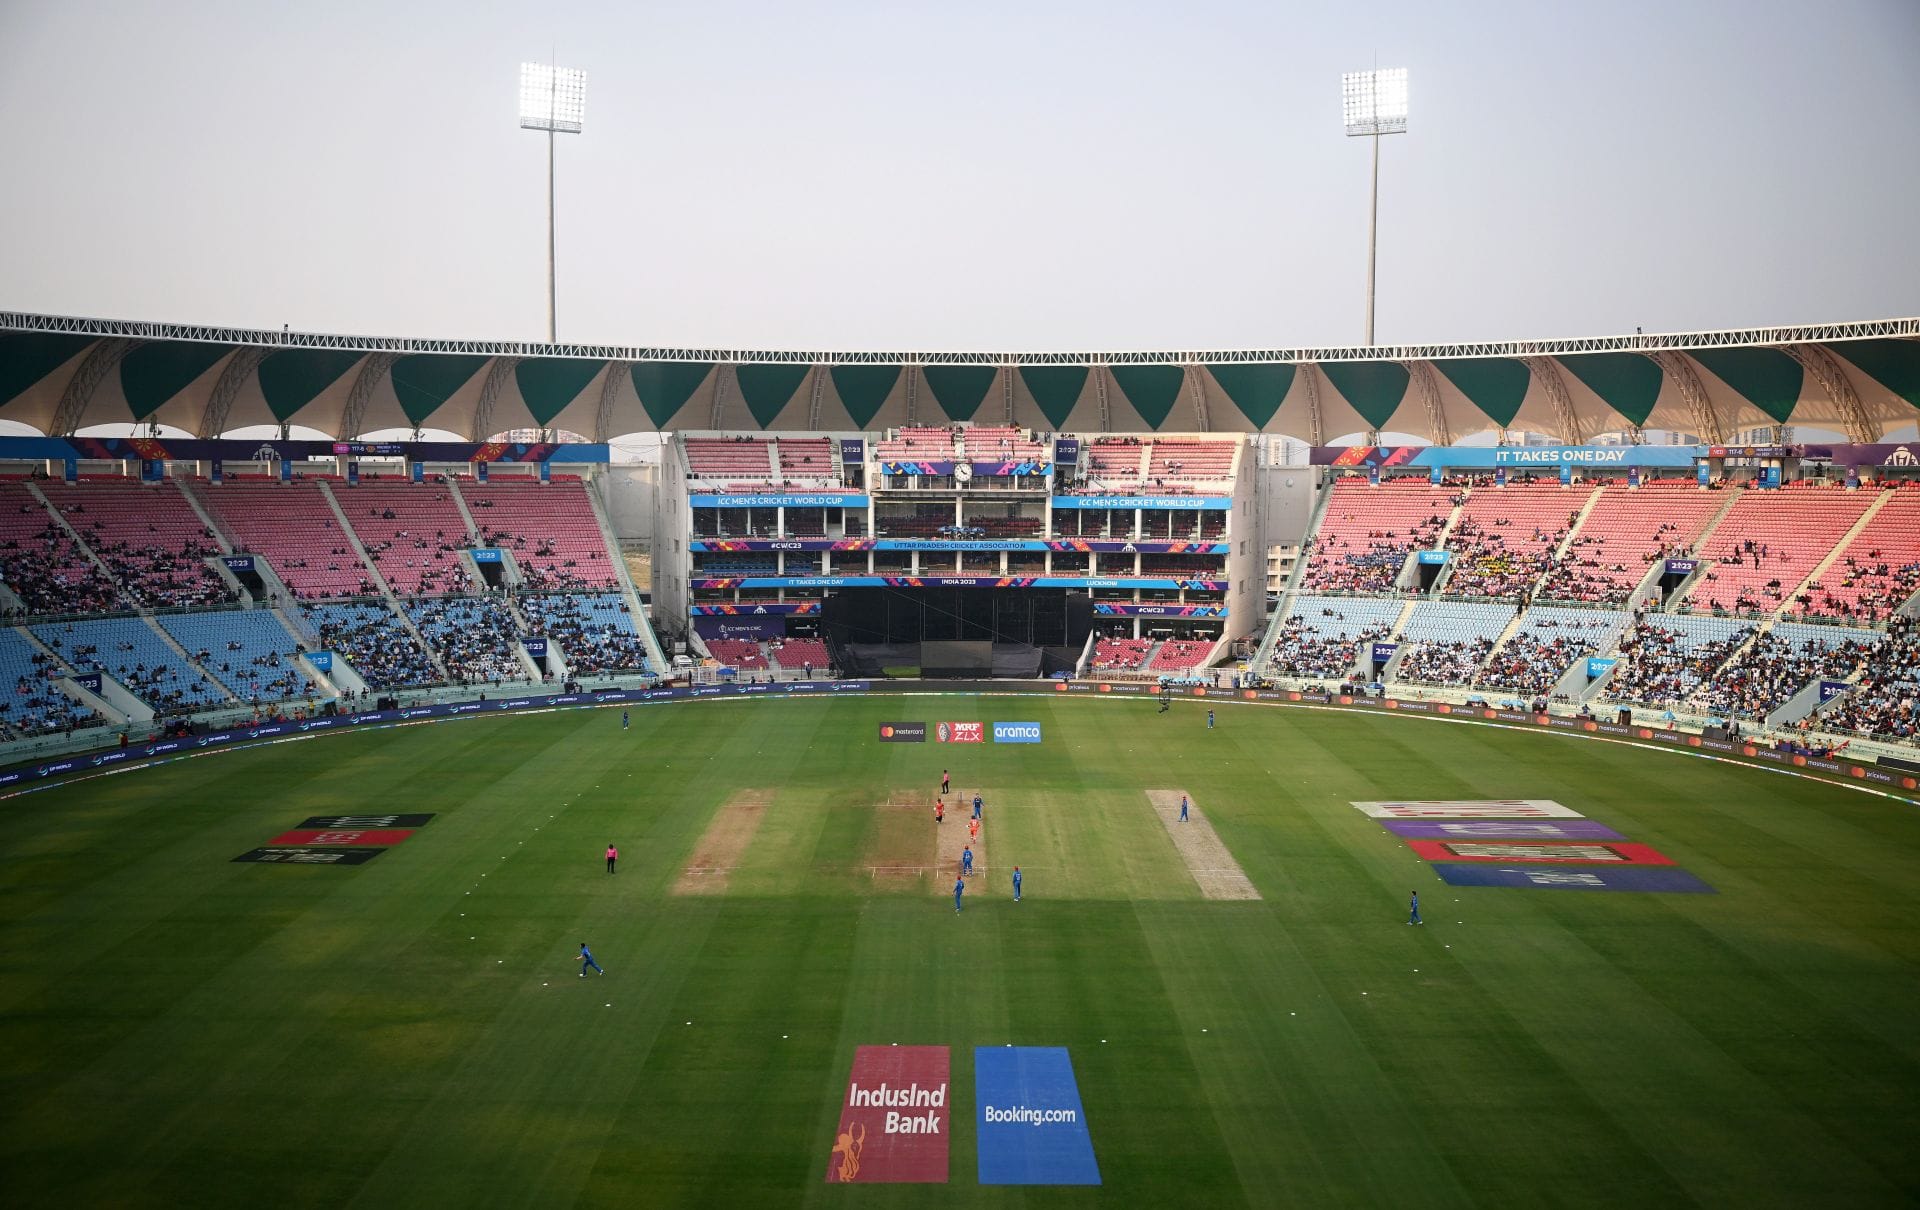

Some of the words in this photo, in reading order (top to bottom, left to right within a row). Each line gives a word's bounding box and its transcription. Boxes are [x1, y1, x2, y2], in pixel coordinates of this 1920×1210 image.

[1496, 450, 1509, 462] IT
[1513, 450, 1559, 462] TAKES
[1563, 450, 1592, 462] ONE
[1595, 450, 1626, 462] DAY
[758, 497, 792, 505] CRICKET
[794, 497, 824, 505] WORLD
[1156, 499, 1186, 507] WORLD
[954, 723, 980, 732] MRF
[995, 727, 1040, 738] aramco
[954, 732, 980, 741] ZLX
[849, 1083, 946, 1107] IndusInd
[985, 1105, 1076, 1126] Booking.com
[884, 1110, 941, 1134] Bank
